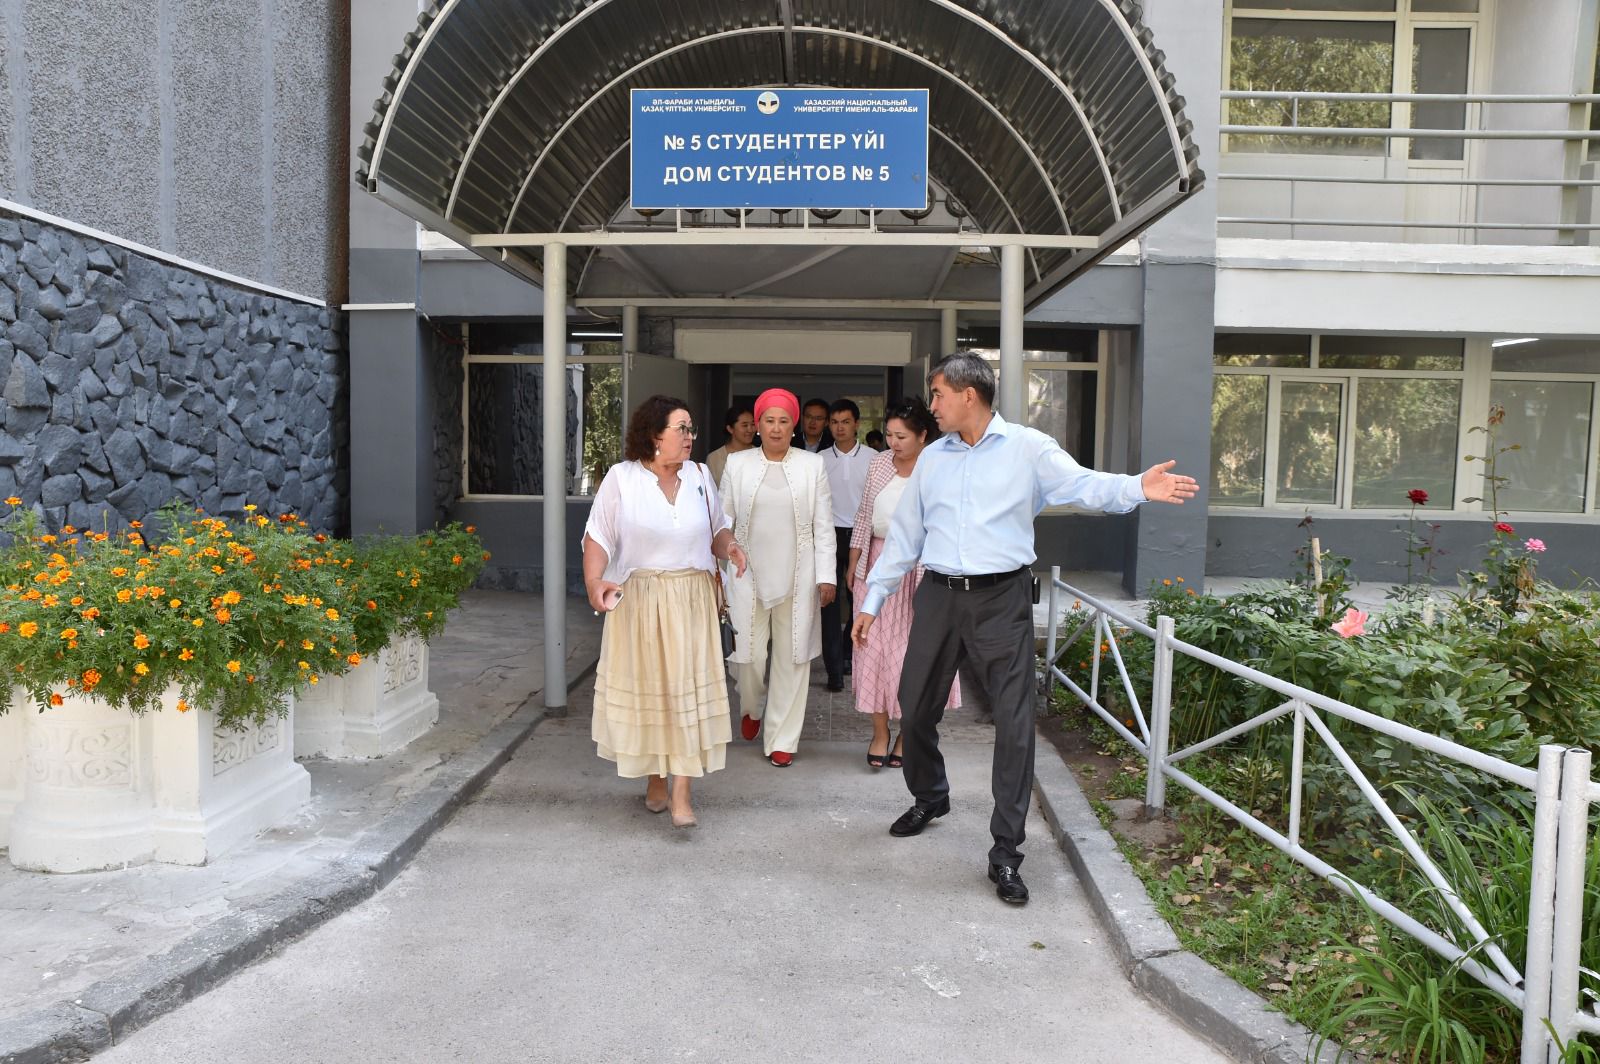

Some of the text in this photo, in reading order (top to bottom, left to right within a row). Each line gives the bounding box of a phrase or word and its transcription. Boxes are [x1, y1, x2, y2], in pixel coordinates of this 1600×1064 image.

[641, 105, 664, 113] ҚАЗАҚ
[804, 98, 908, 107] КАЗАХСКИЙ НАЦИОНАЛЬНЫЙ
[664, 130, 885, 152] № 5 СТУДЕНТТЕР ҮЙІ
[664, 165, 890, 185] ДОМ СТУДЕНТОВ № 5
